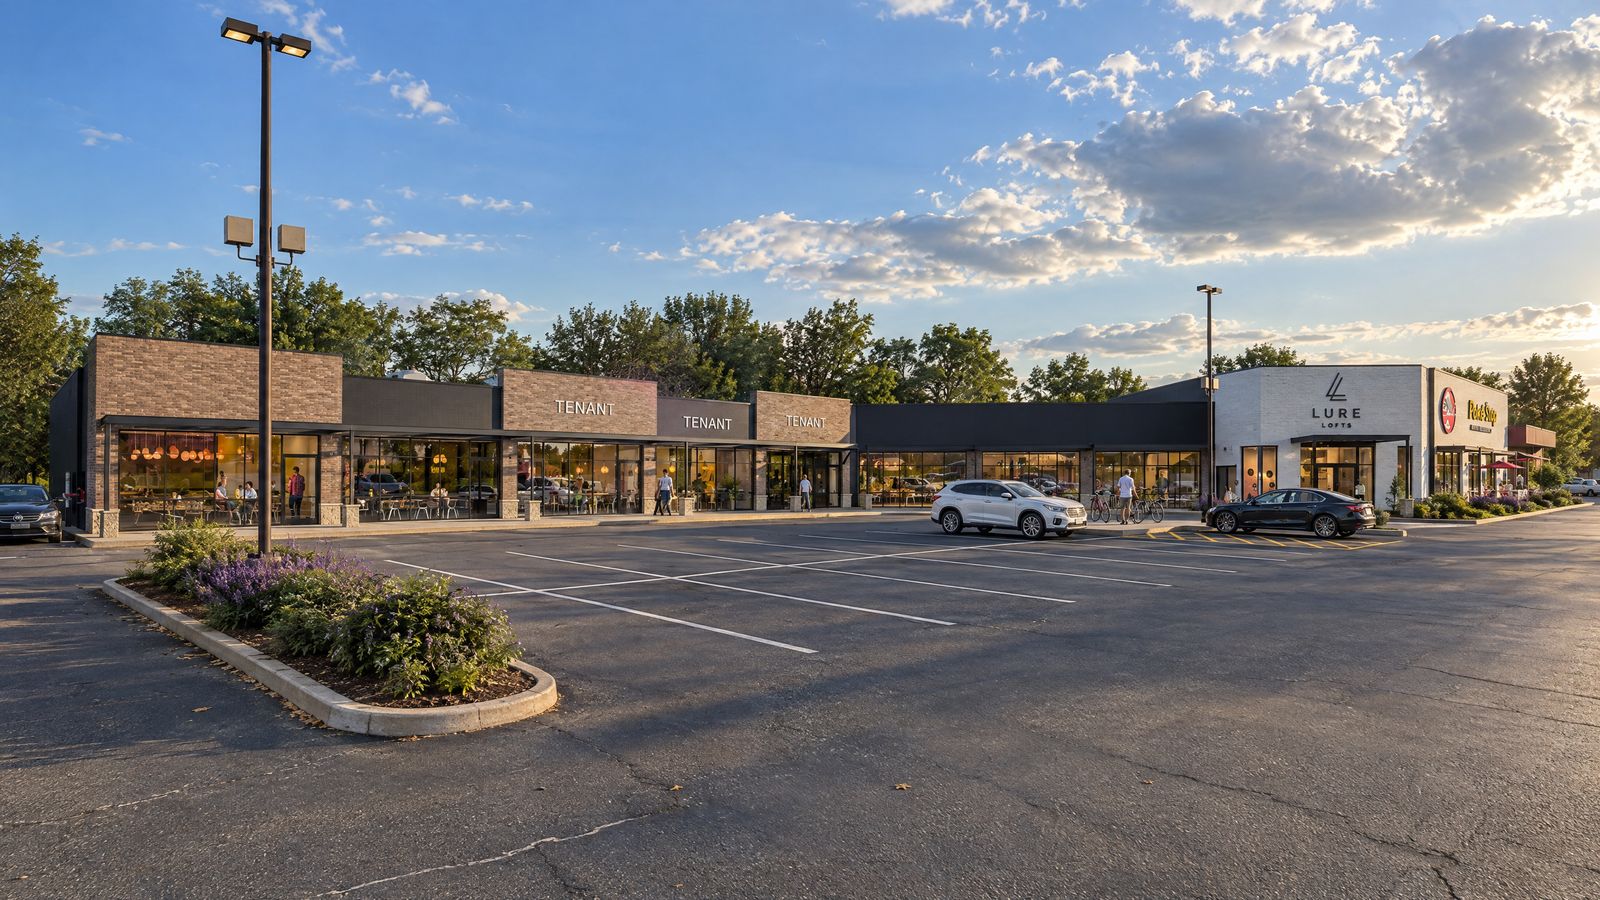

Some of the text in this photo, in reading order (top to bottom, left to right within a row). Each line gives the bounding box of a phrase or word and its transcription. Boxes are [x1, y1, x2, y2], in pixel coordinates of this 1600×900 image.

[555, 399, 615, 416] TENANT
[1312, 408, 1361, 419] LURE
[683, 415, 732, 431] TENANT
[786, 414, 827, 429] TENANT
